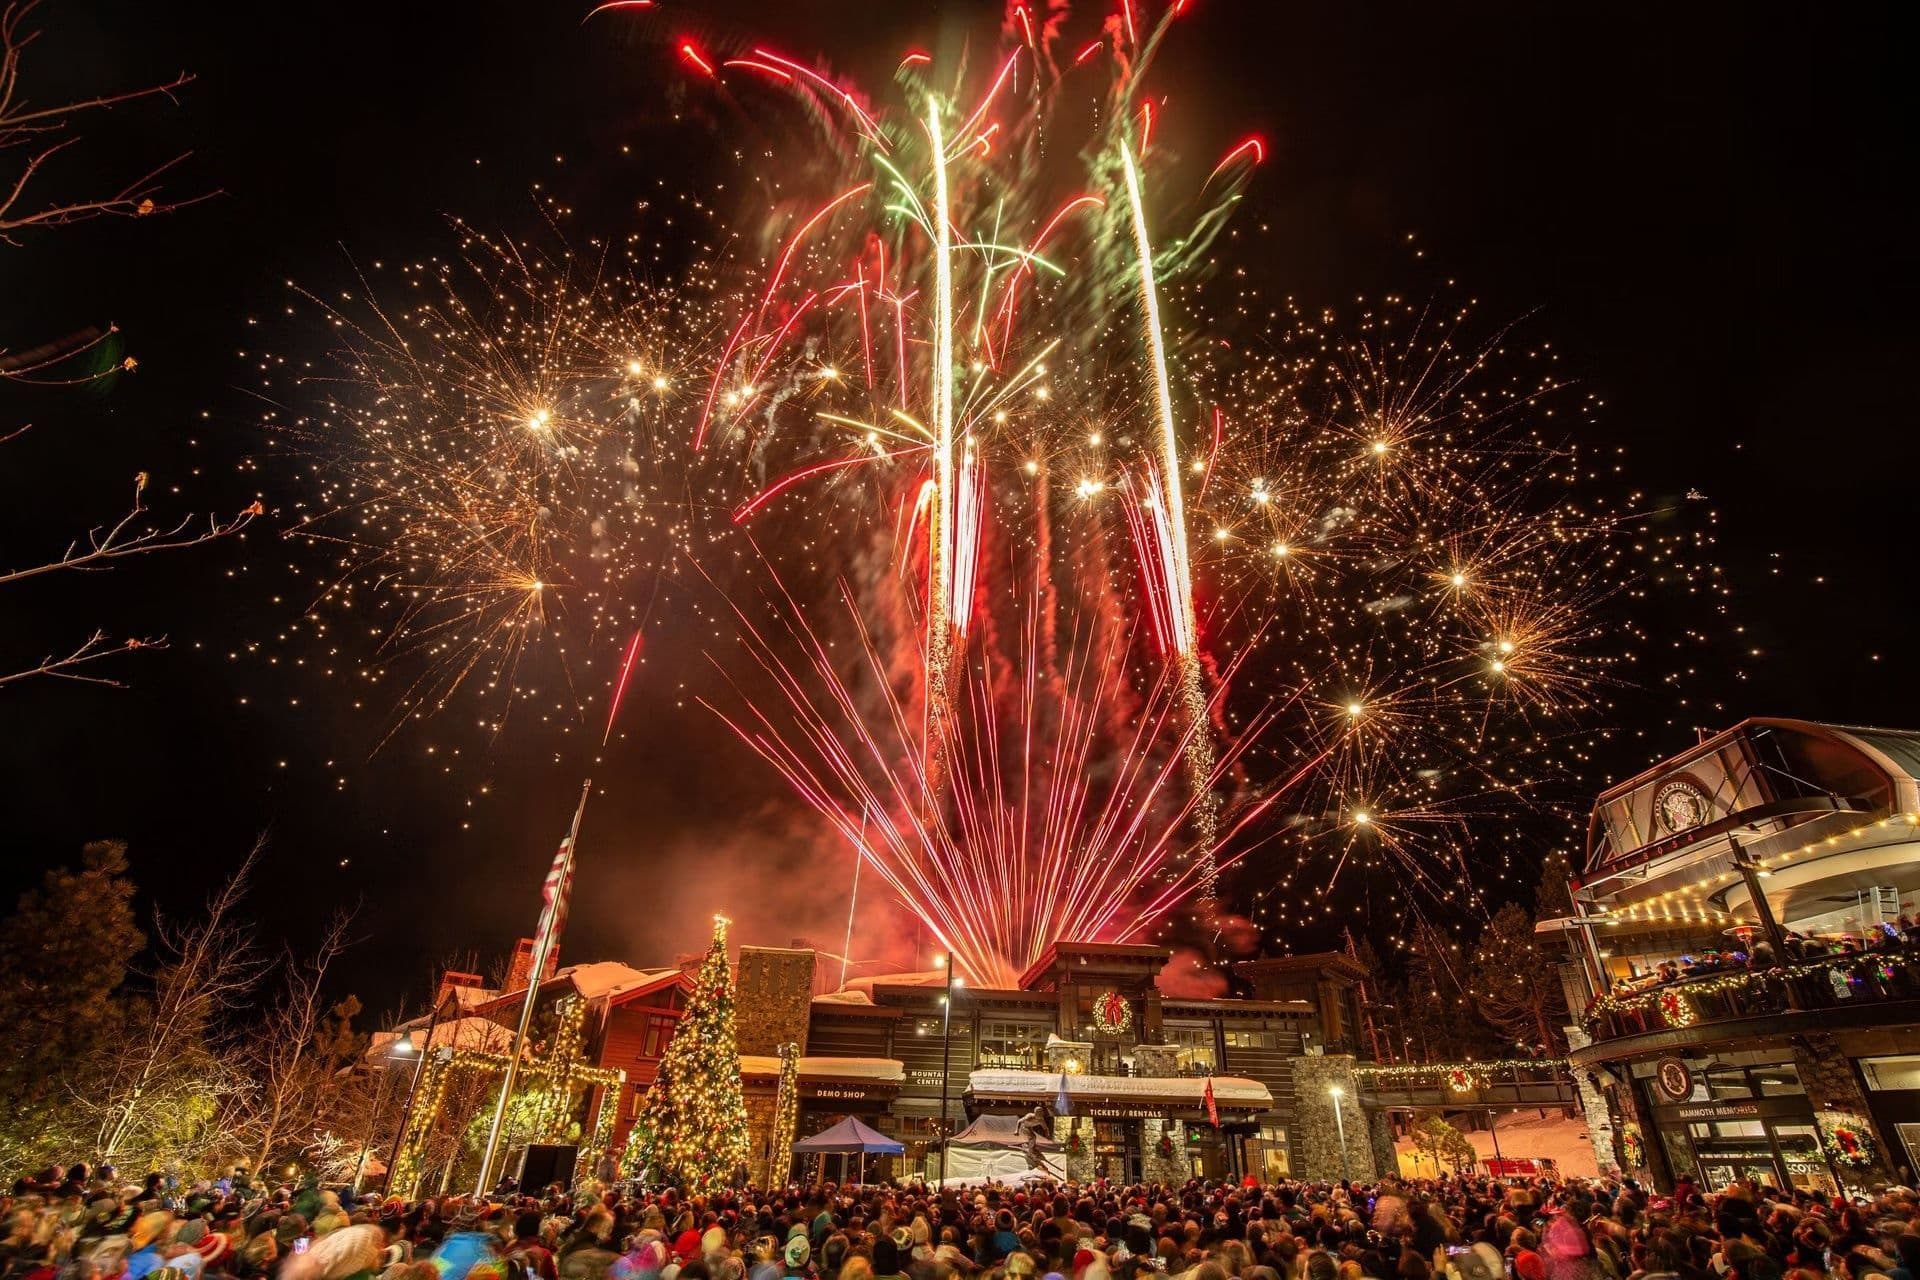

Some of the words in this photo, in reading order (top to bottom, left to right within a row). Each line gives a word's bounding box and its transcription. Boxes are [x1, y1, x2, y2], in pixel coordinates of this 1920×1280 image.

[1090, 1109, 1120, 1117] TICKETS
[1128, 1110, 1162, 1118] RENTALS
[1679, 1107, 1715, 1118] MAMMOTH
[1716, 1105, 1758, 1116] MEMORIES
